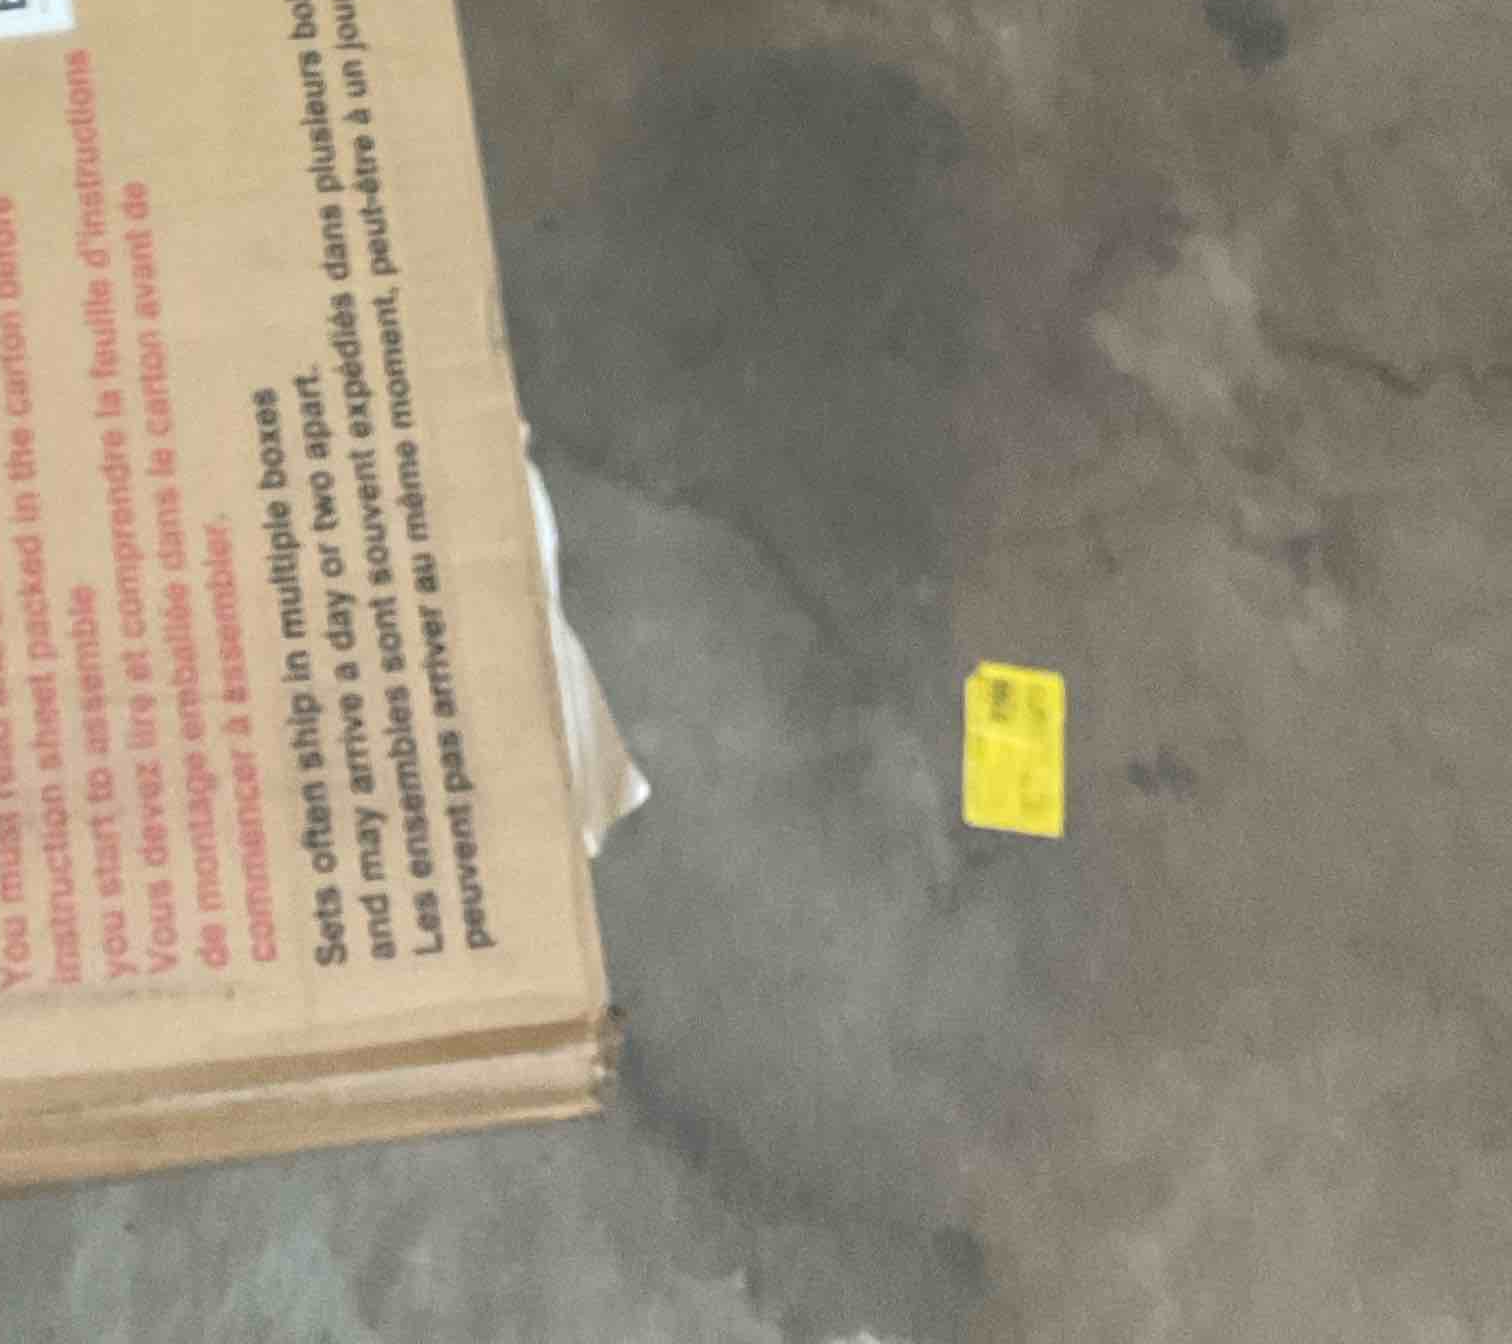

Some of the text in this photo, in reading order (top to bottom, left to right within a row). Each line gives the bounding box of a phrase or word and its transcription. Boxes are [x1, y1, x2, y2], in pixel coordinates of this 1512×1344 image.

[297, 49, 346, 194] plusieurs
[341, 58, 369, 99] un
[342, 107, 372, 126] à
[318, 203, 352, 282] dans
[351, 134, 400, 277] peut-être
[326, 290, 375, 440] expédiés
[371, 286, 414, 430] moment,
[347, 448, 394, 587] souvent
[394, 439, 430, 543] même
[367, 595, 406, 674] sont
[410, 551, 441, 596] au
[251, 386, 349, 968] Sets often ship in multiple boxes
[291, 365, 398, 961] and may arrive a day or two apart.
[417, 604, 459, 720] arriver
[382, 684, 436, 880] ensembles
[436, 728, 477, 795] pas
[412, 888, 445, 957] Les
[444, 799, 498, 952] peuvent
